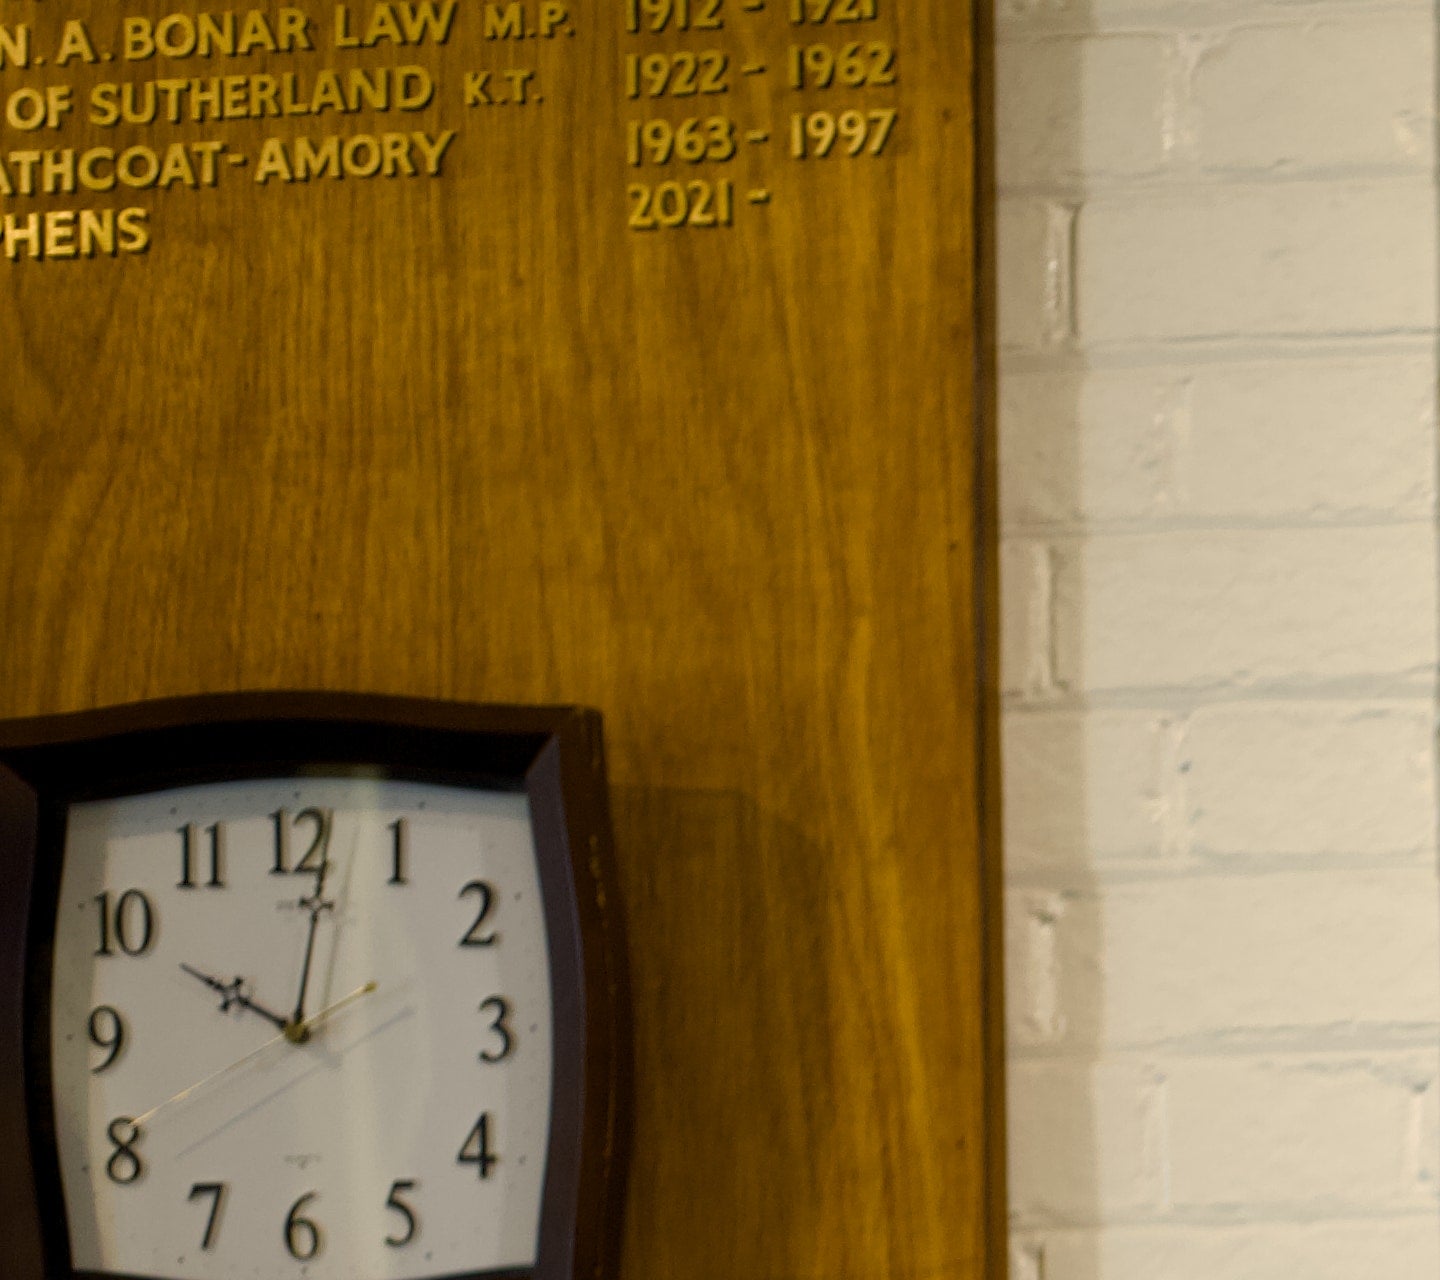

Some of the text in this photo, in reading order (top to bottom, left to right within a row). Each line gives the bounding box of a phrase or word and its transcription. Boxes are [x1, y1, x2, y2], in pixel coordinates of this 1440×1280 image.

[124, 9, 313, 60] BONAR
[335, 1, 457, 47] LAW
[6, 86, 73, 130] OF
[89, 65, 435, 126] SUTHERLAND
[626, 50, 728, 98] 1922
[789, 41, 895, 89] 1962
[628, 116, 736, 165] 1963
[791, 109, 897, 158] 1997
[0, 207, 149, 258] HENS
[629, 180, 733, 229] 2021
[175, 822, 225, 889] 11
[269, 807, 328, 876] 12
[386, 819, 410, 885] 1
[94, 889, 155, 957] 10
[458, 881, 498, 948] 2
[88, 1006, 124, 1074] 9
[478, 996, 514, 1063] 3
[105, 1116, 144, 1186] 8
[457, 1113, 499, 1179] 4
[188, 1182, 227, 1250] 7
[283, 1192, 321, 1260] 6
[385, 1181, 416, 1247] 5
